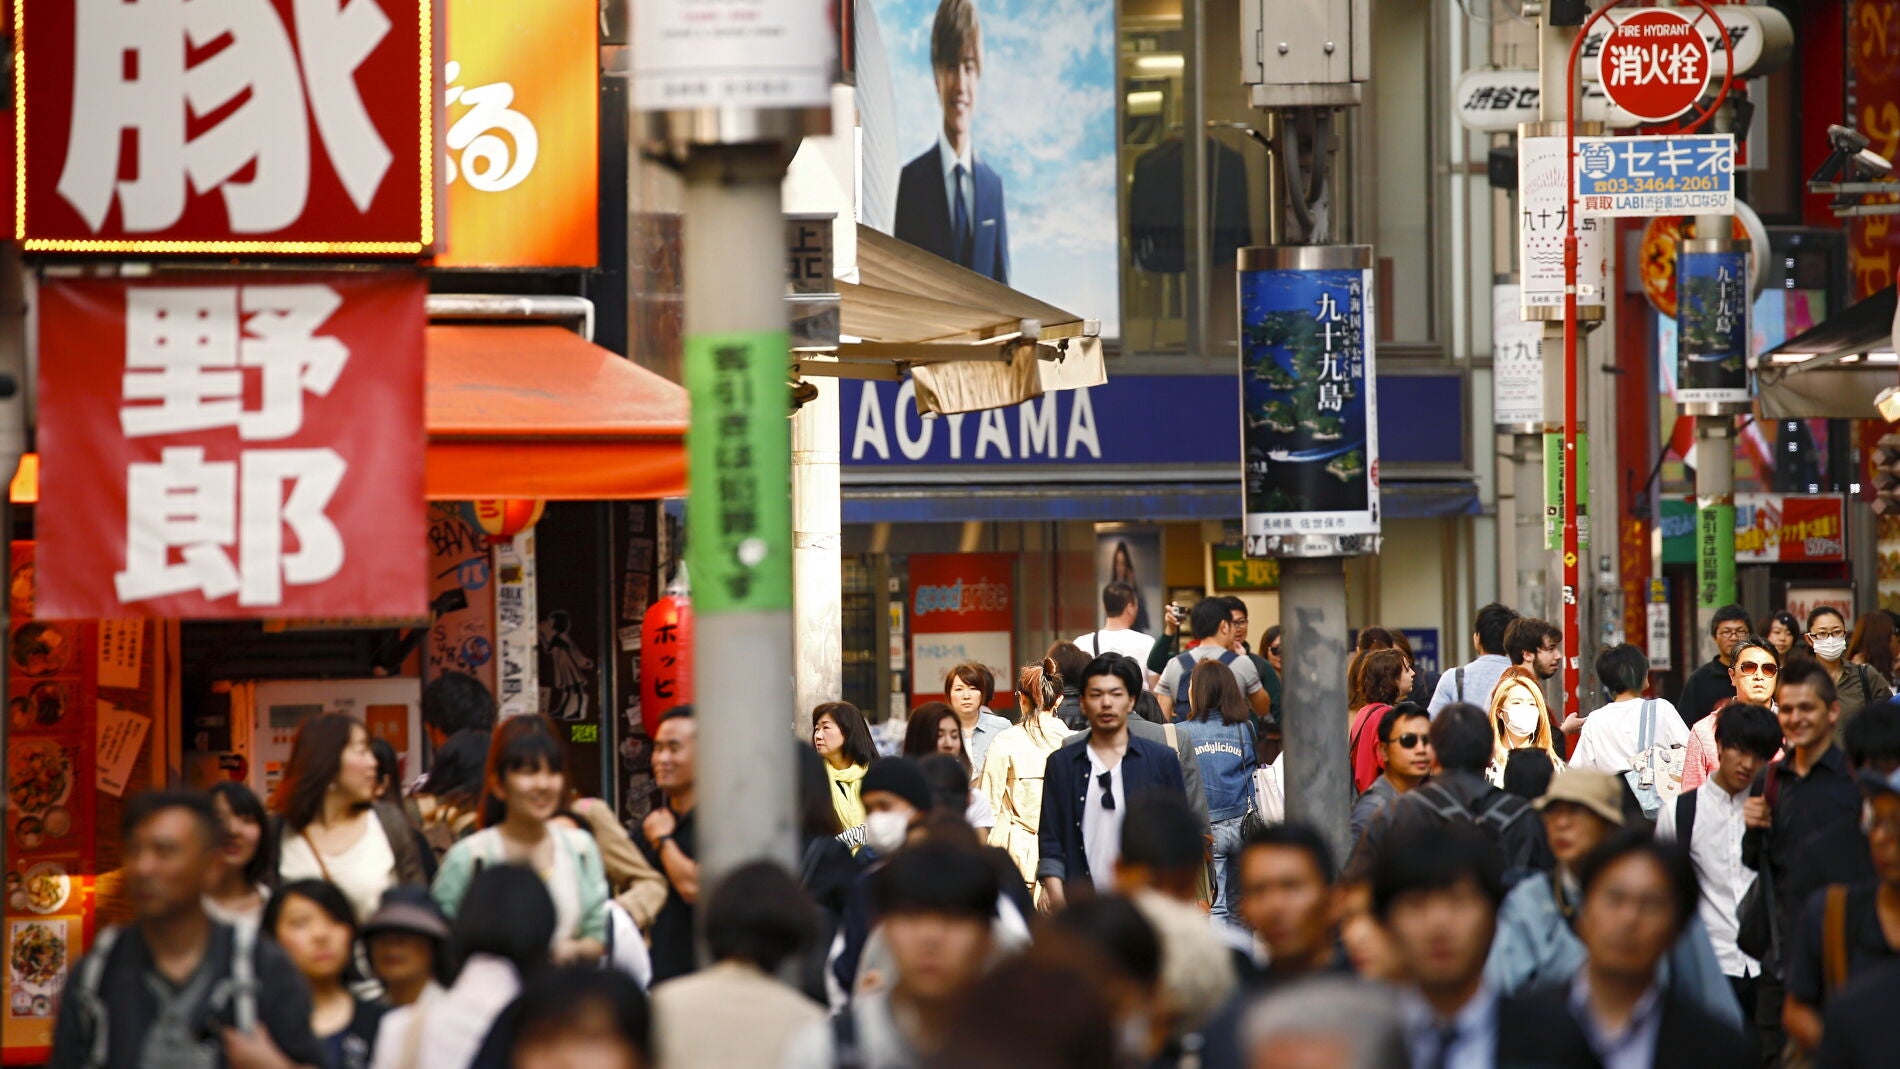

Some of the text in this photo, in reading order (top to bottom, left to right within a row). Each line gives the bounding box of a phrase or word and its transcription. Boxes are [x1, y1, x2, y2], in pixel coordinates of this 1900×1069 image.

[1618, 24, 1690, 38] FIRE HYDRANT
[1610, 43, 1701, 86] 消火栓
[57, 0, 394, 234] 豚
[445, 60, 539, 192] る
[1619, 140, 1732, 177] セキネ
[1585, 196, 1613, 210] 買取
[1608, 177, 1719, 193] 03-3464-2061
[1316, 292, 1343, 411] 九十九島
[851, 379, 1102, 460] AOYAMA
[115, 284, 350, 606] 野郎
[1263, 519, 1292, 530] 長崎県
[1218, 560, 1279, 587] 下取
[1703, 510, 1719, 605] 客引きは犯罪です
[1195, 742, 1243, 758] andylicious
